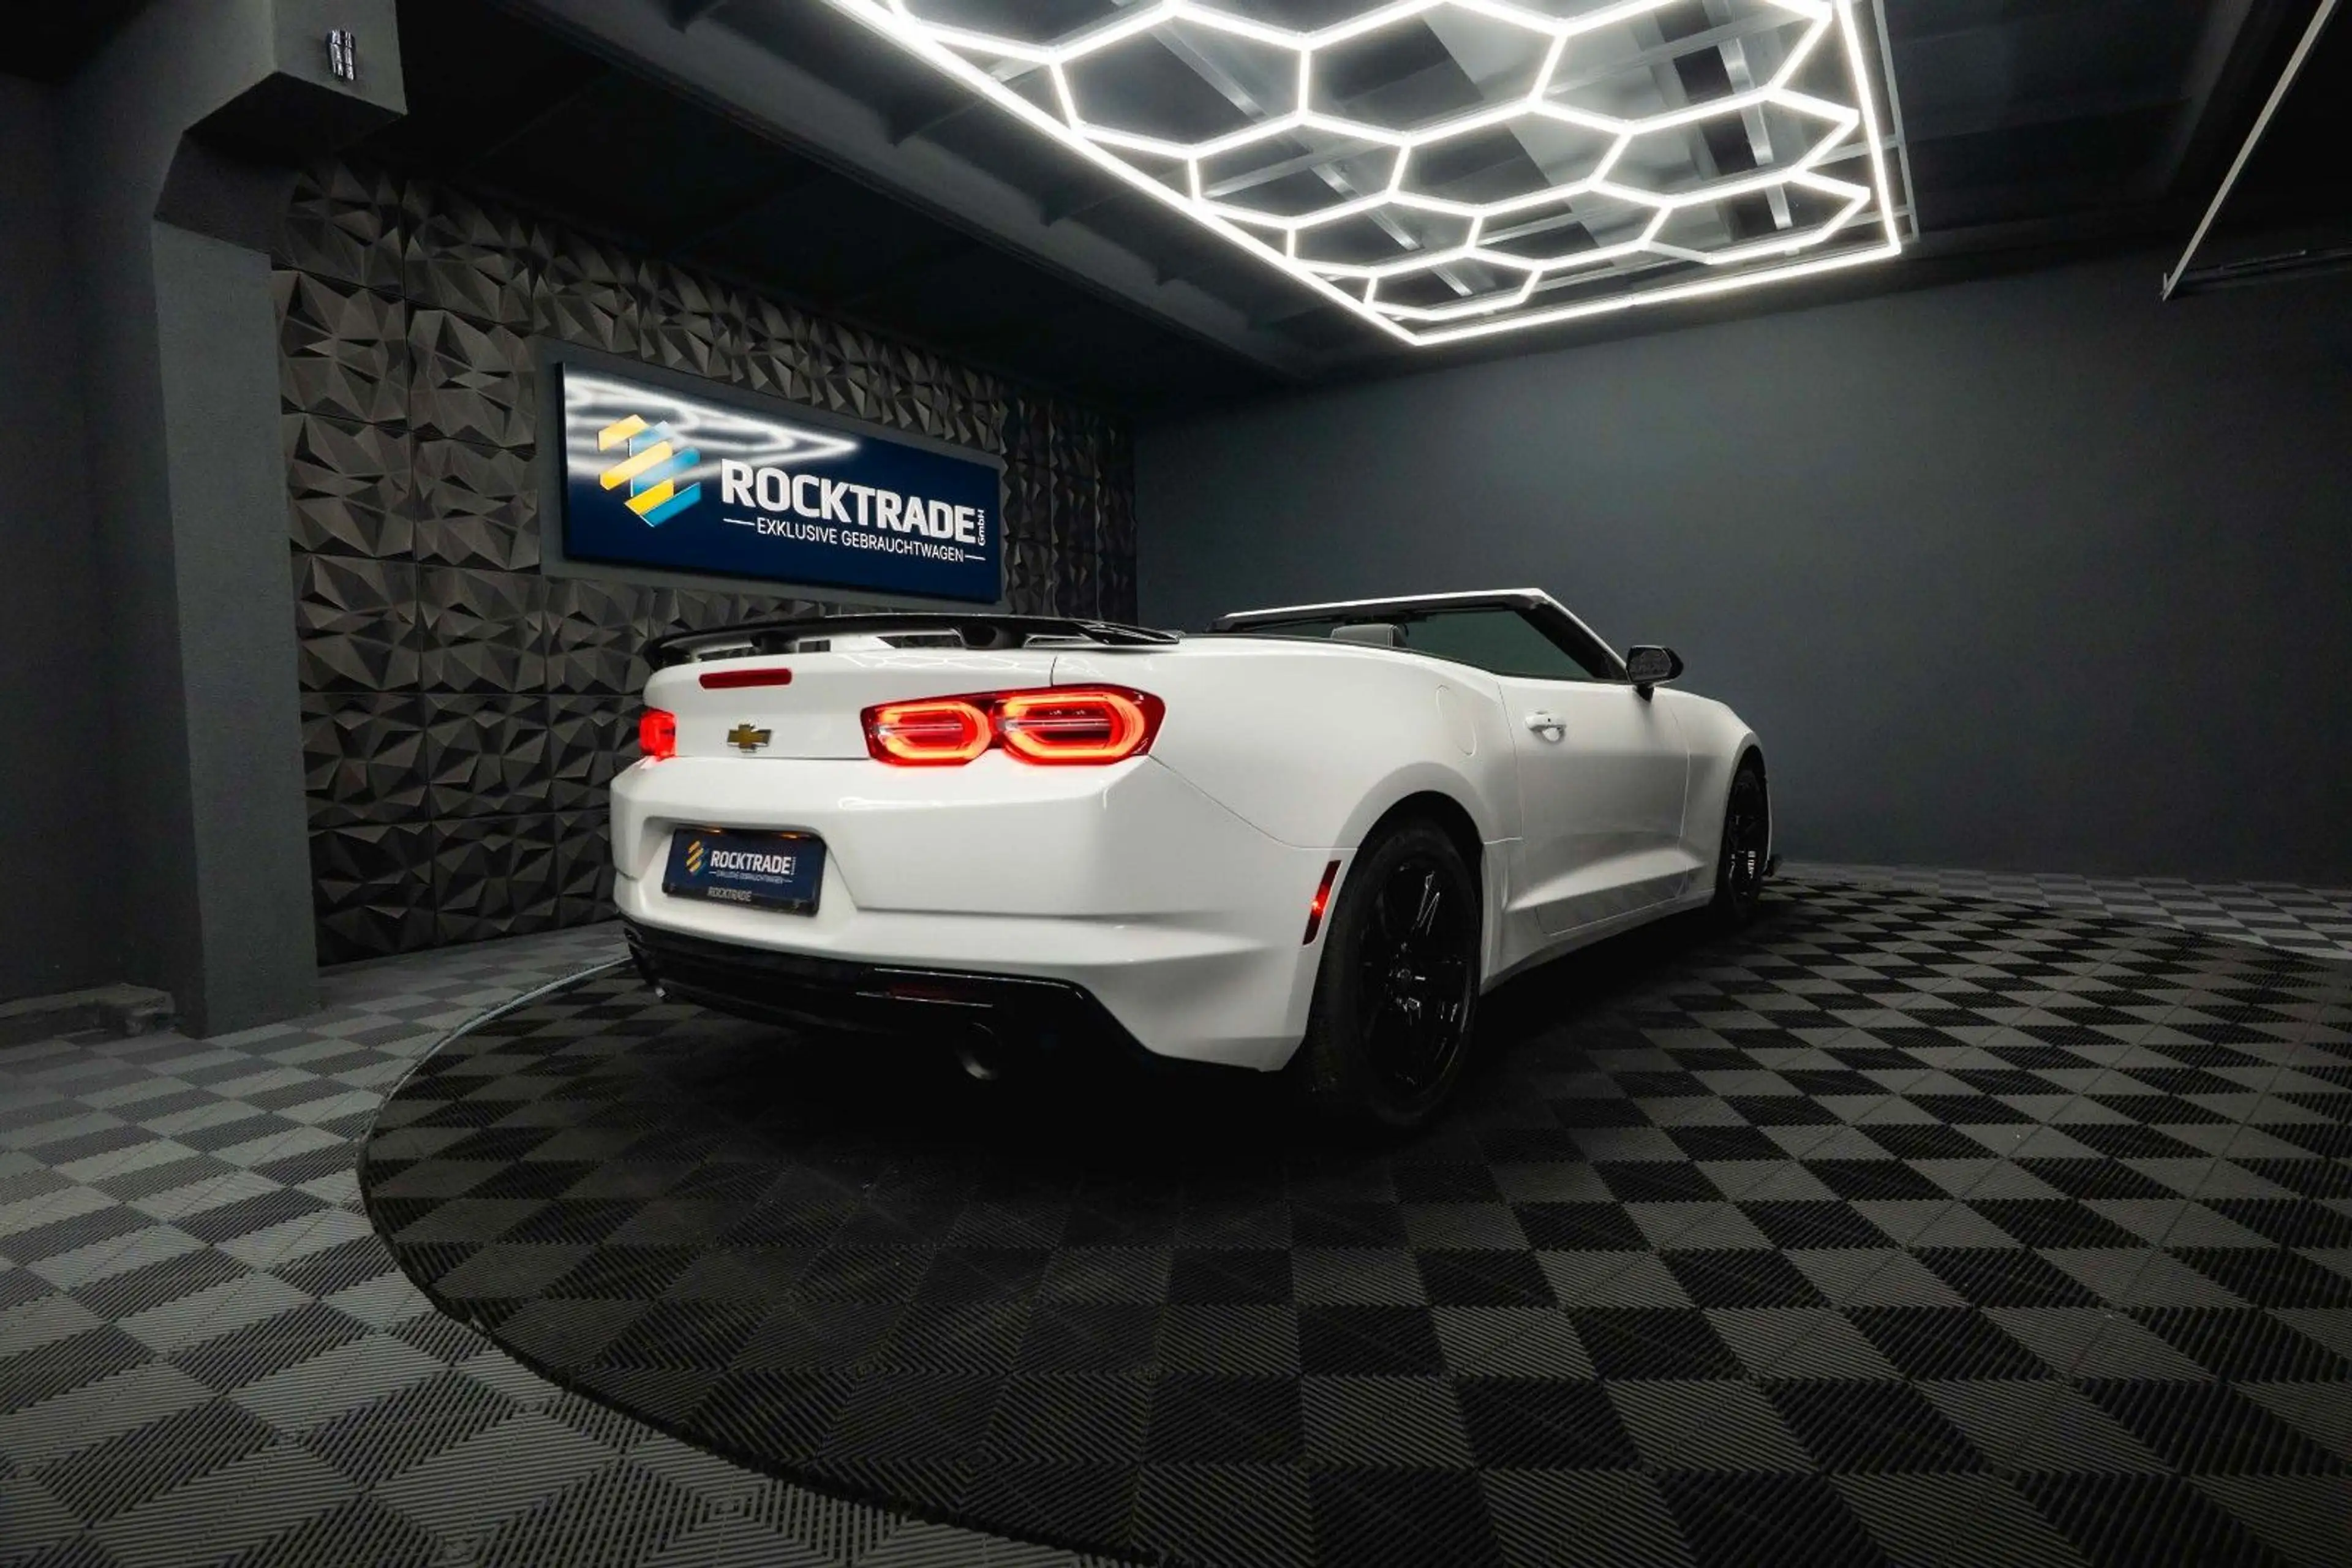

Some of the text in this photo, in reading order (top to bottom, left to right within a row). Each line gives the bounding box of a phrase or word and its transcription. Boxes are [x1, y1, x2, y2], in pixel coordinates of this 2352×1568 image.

[722, 459, 976, 544] ROCKTRADE
[756, 517, 963, 562] EXKLUSIVE GEBRAUCHTWAGEN
[977, 508, 986, 546] GmbH
[710, 850, 791, 875] ROCKTRADE
